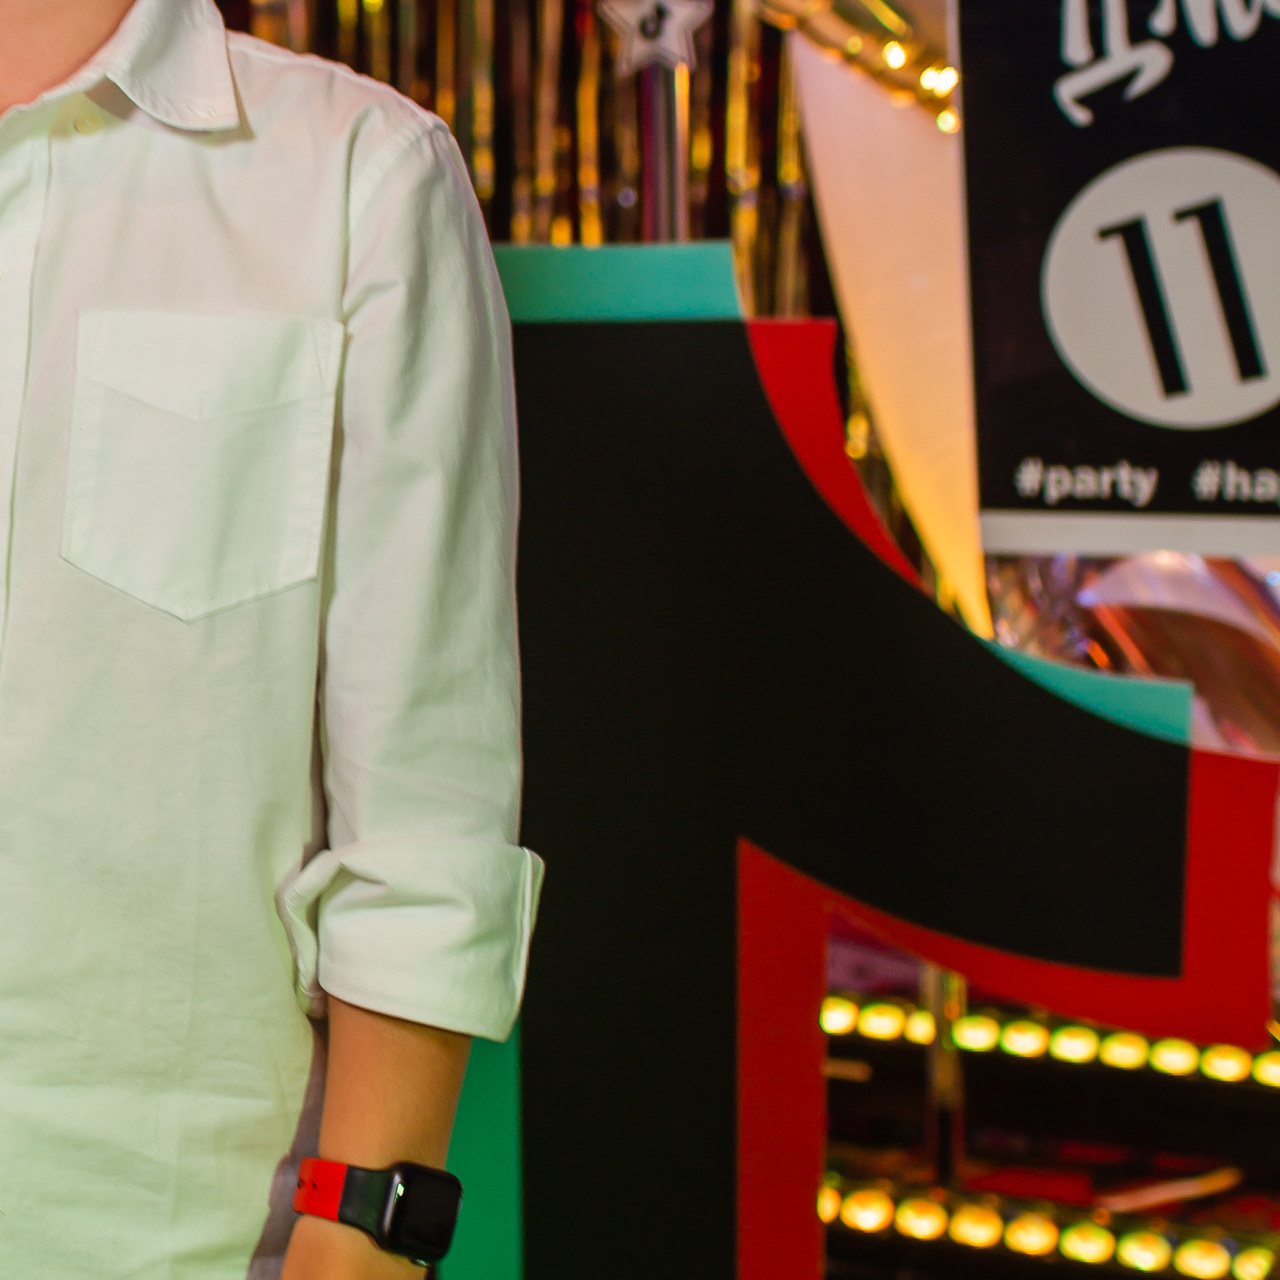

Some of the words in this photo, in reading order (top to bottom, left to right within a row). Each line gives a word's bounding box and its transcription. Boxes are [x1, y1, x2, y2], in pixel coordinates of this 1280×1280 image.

[1096, 196, 1268, 400] 11
[1015, 456, 1159, 506] #party
[1191, 459, 1280, 507] #ha
